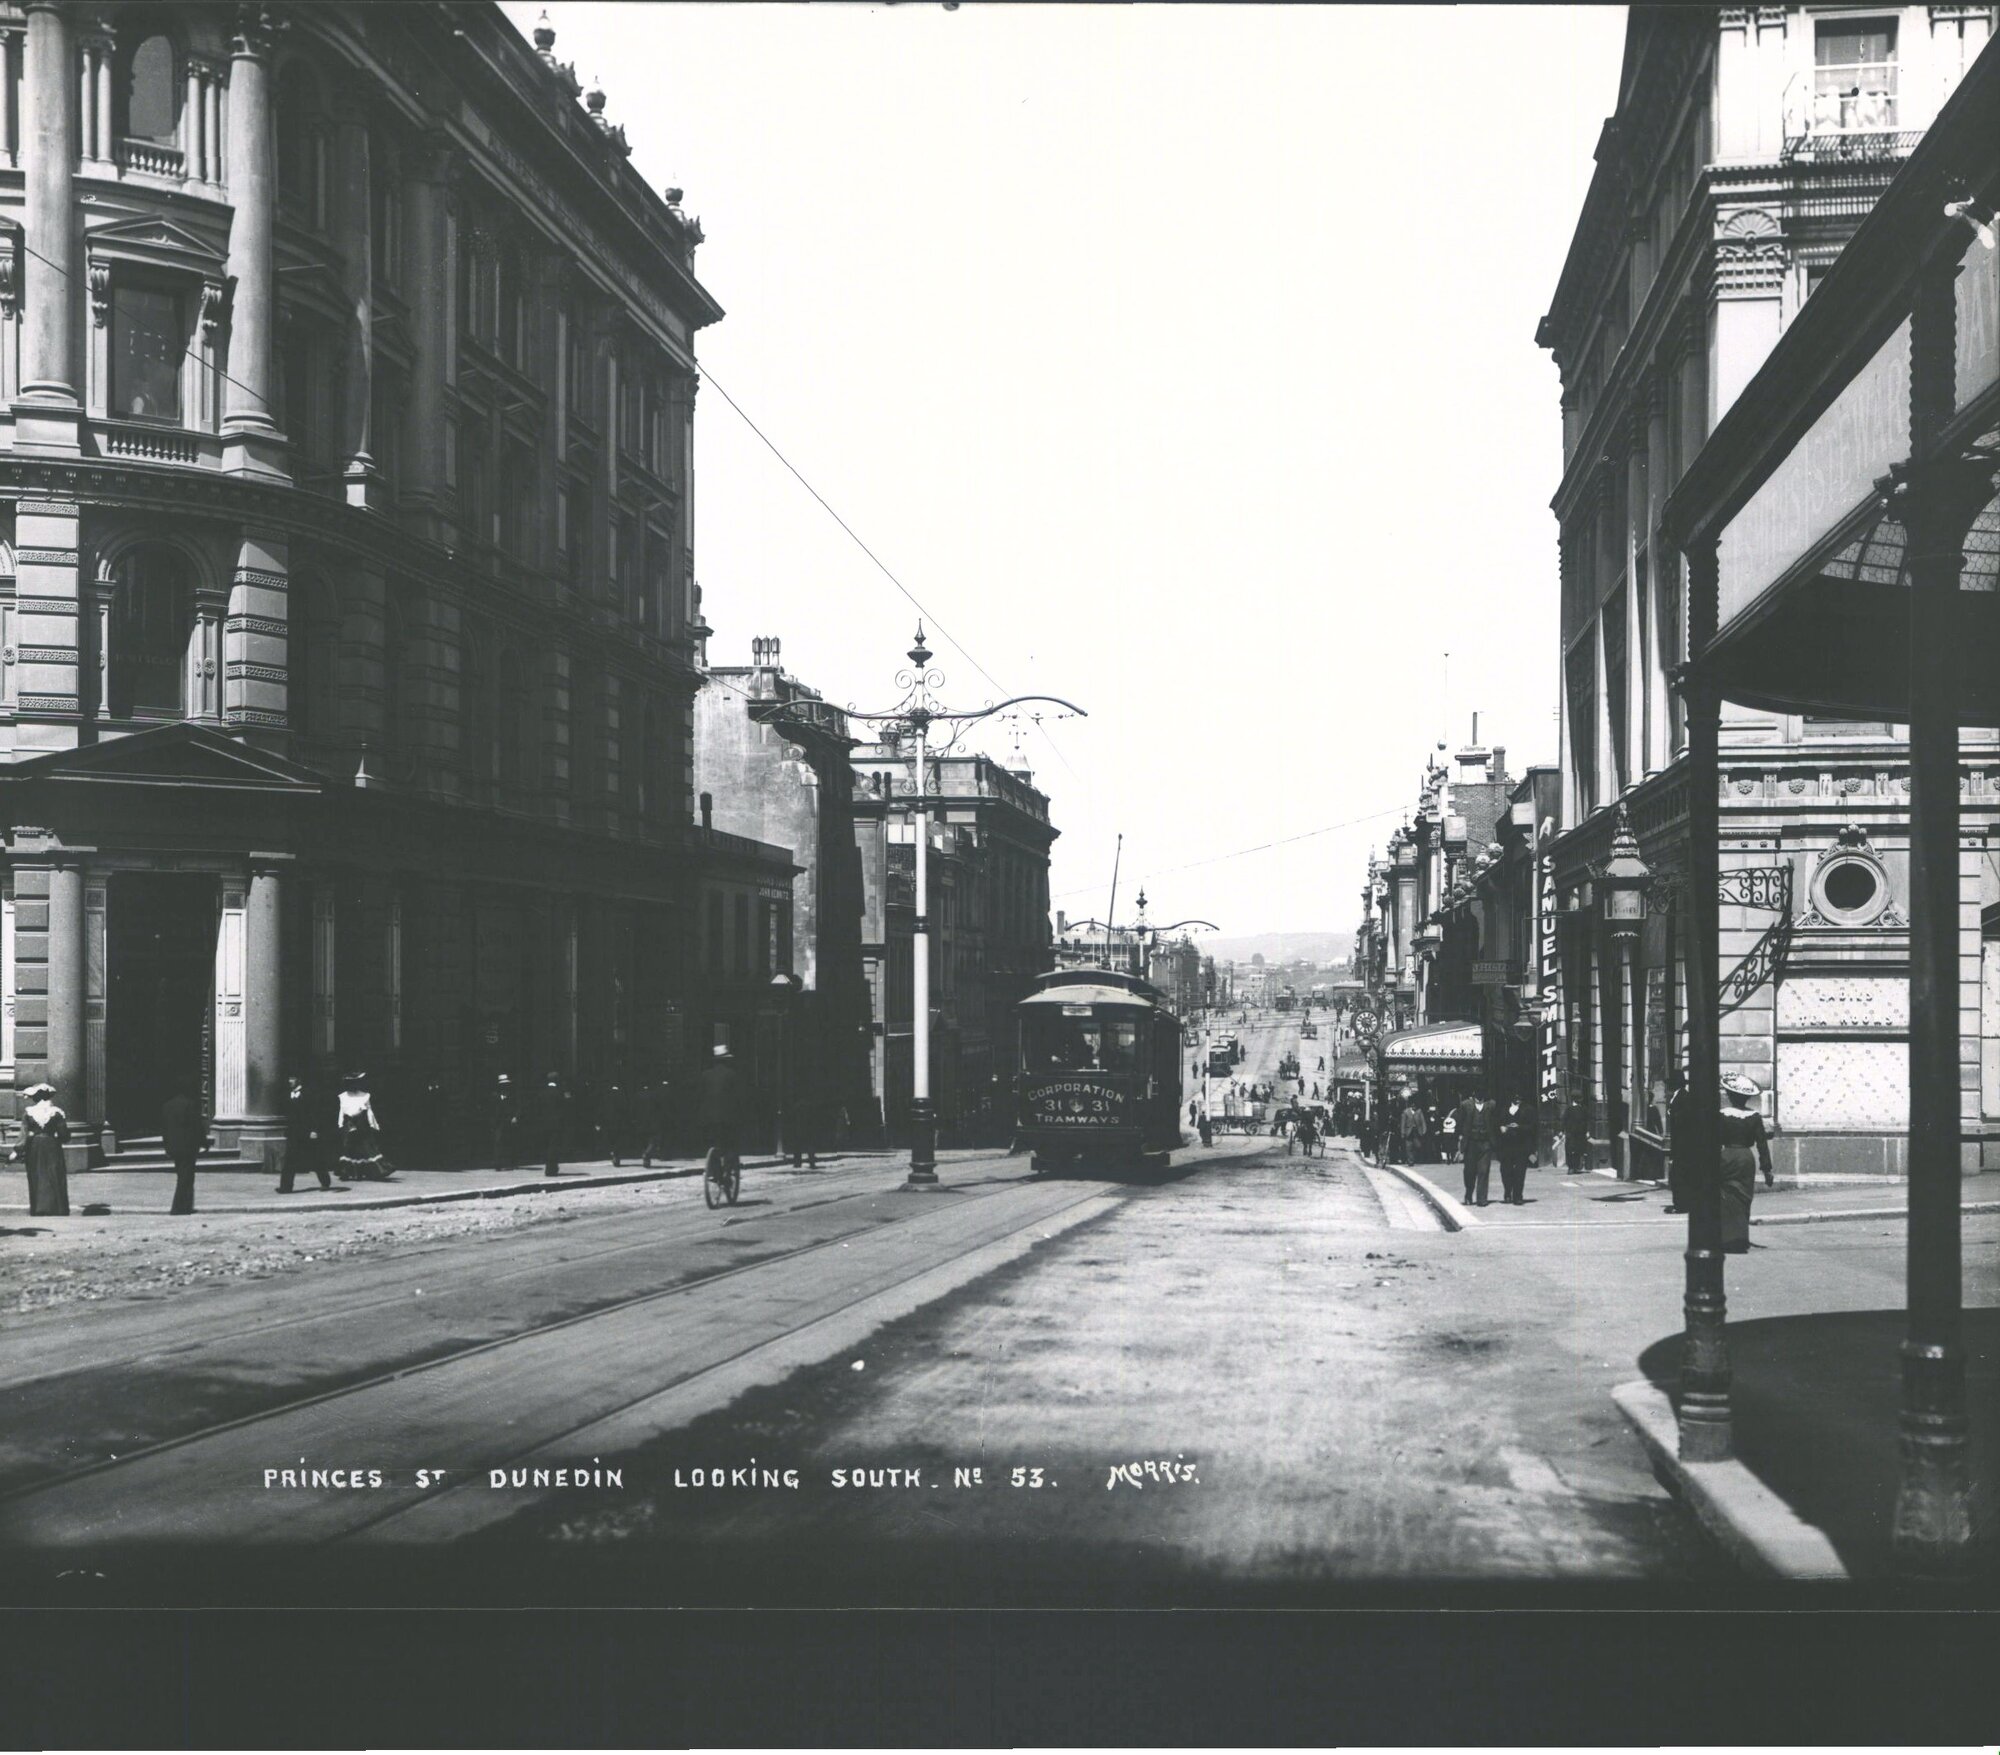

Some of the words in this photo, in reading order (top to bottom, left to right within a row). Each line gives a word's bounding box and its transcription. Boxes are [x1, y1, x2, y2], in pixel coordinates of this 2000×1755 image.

[1541, 855, 1557, 977] SAMUEL
[1819, 991, 1873, 1001] LADIES
[1799, 1016, 1827, 1026] TEA
[1840, 1016, 1893, 1026] ROOMS
[1541, 985, 1558, 1089] SMITH
[1028, 1083, 1124, 1103] CORPORATION
[1045, 1100, 1062, 1111] 31
[1092, 1100, 1109, 1111] 31
[1035, 1113, 1120, 1123] TRAMWAYS
